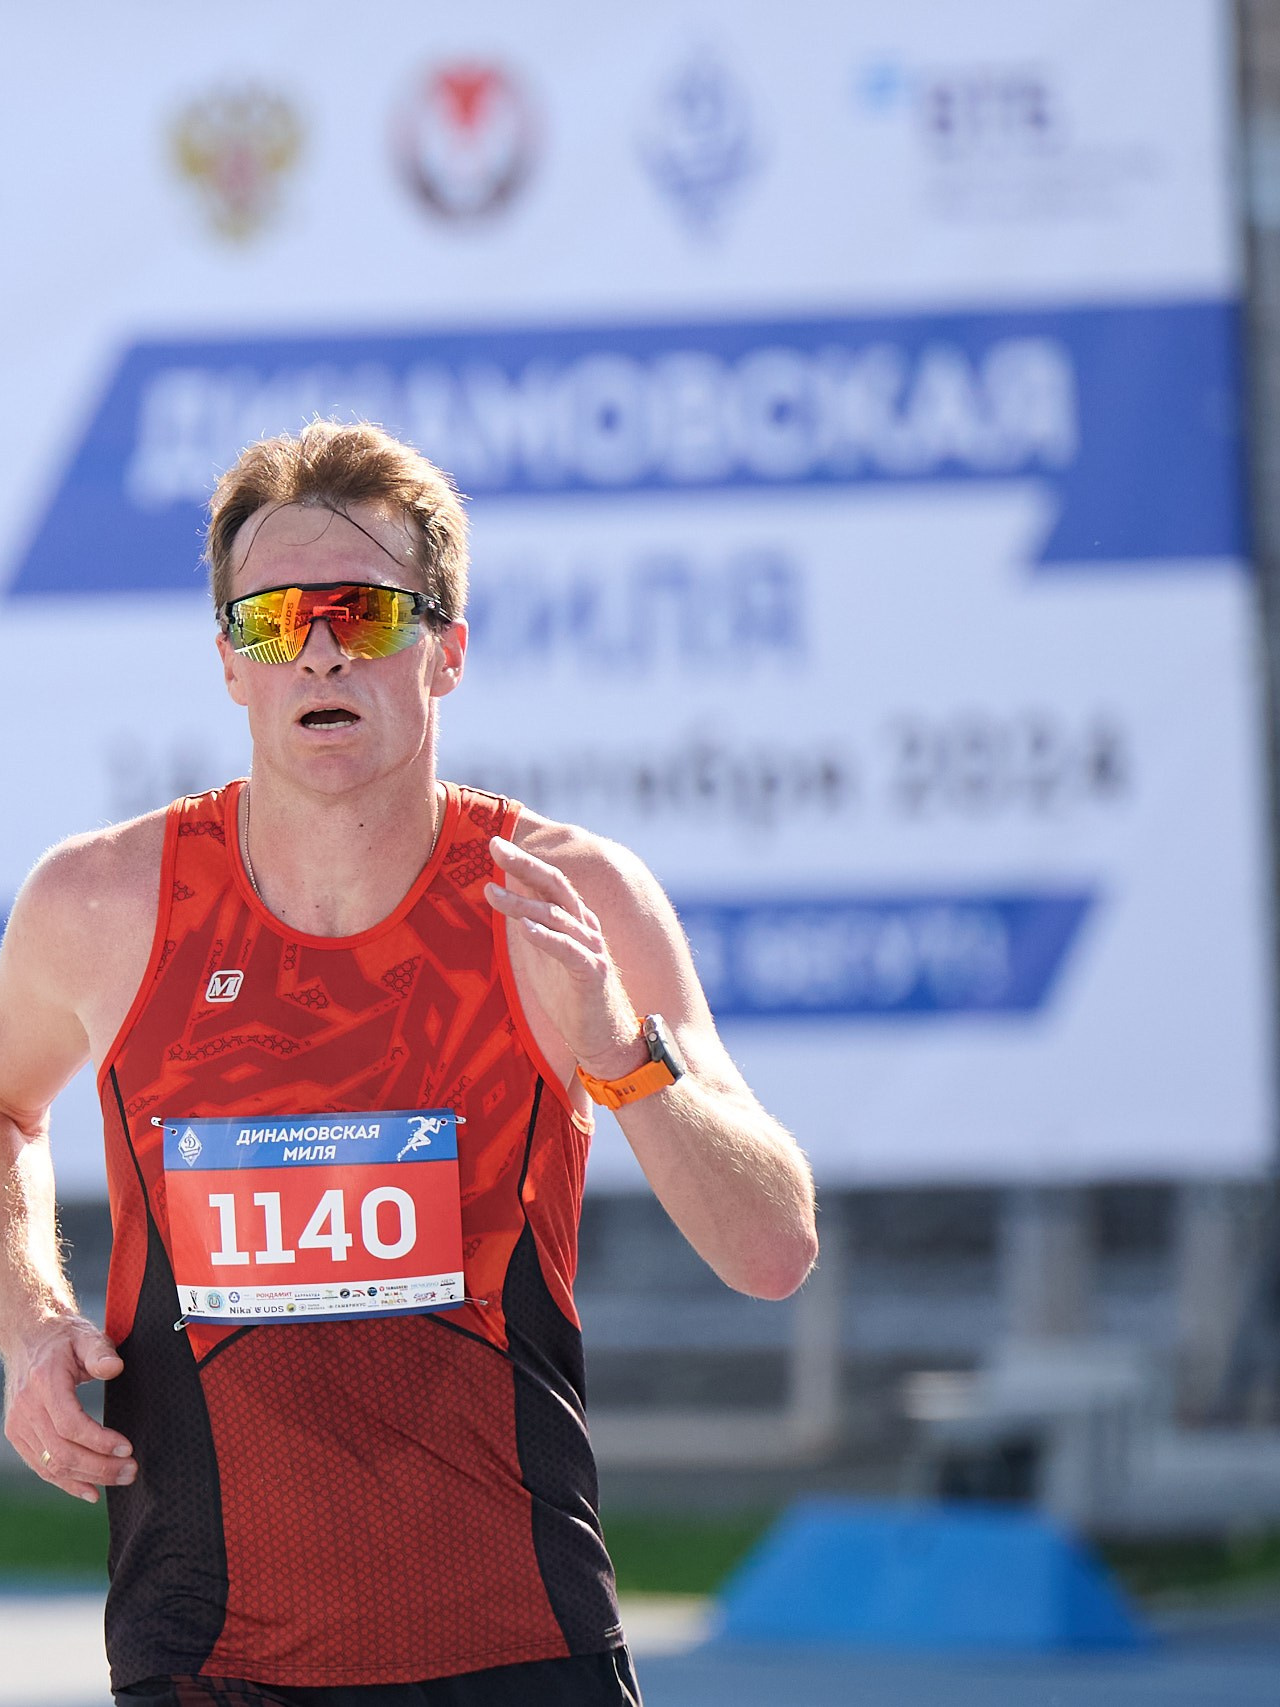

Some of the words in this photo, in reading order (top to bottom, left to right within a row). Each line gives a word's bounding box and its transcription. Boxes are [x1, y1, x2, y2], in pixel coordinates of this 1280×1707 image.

[888, 712, 1132, 816] 2024
[236, 1124, 380, 1146] ДИНАМОВСКАЯ
[283, 1145, 336, 1161] МИЛЯ
[208, 1186, 417, 1266] 1140
[229, 1306, 251, 1314] Nika
[263, 1305, 284, 1314] UDS
